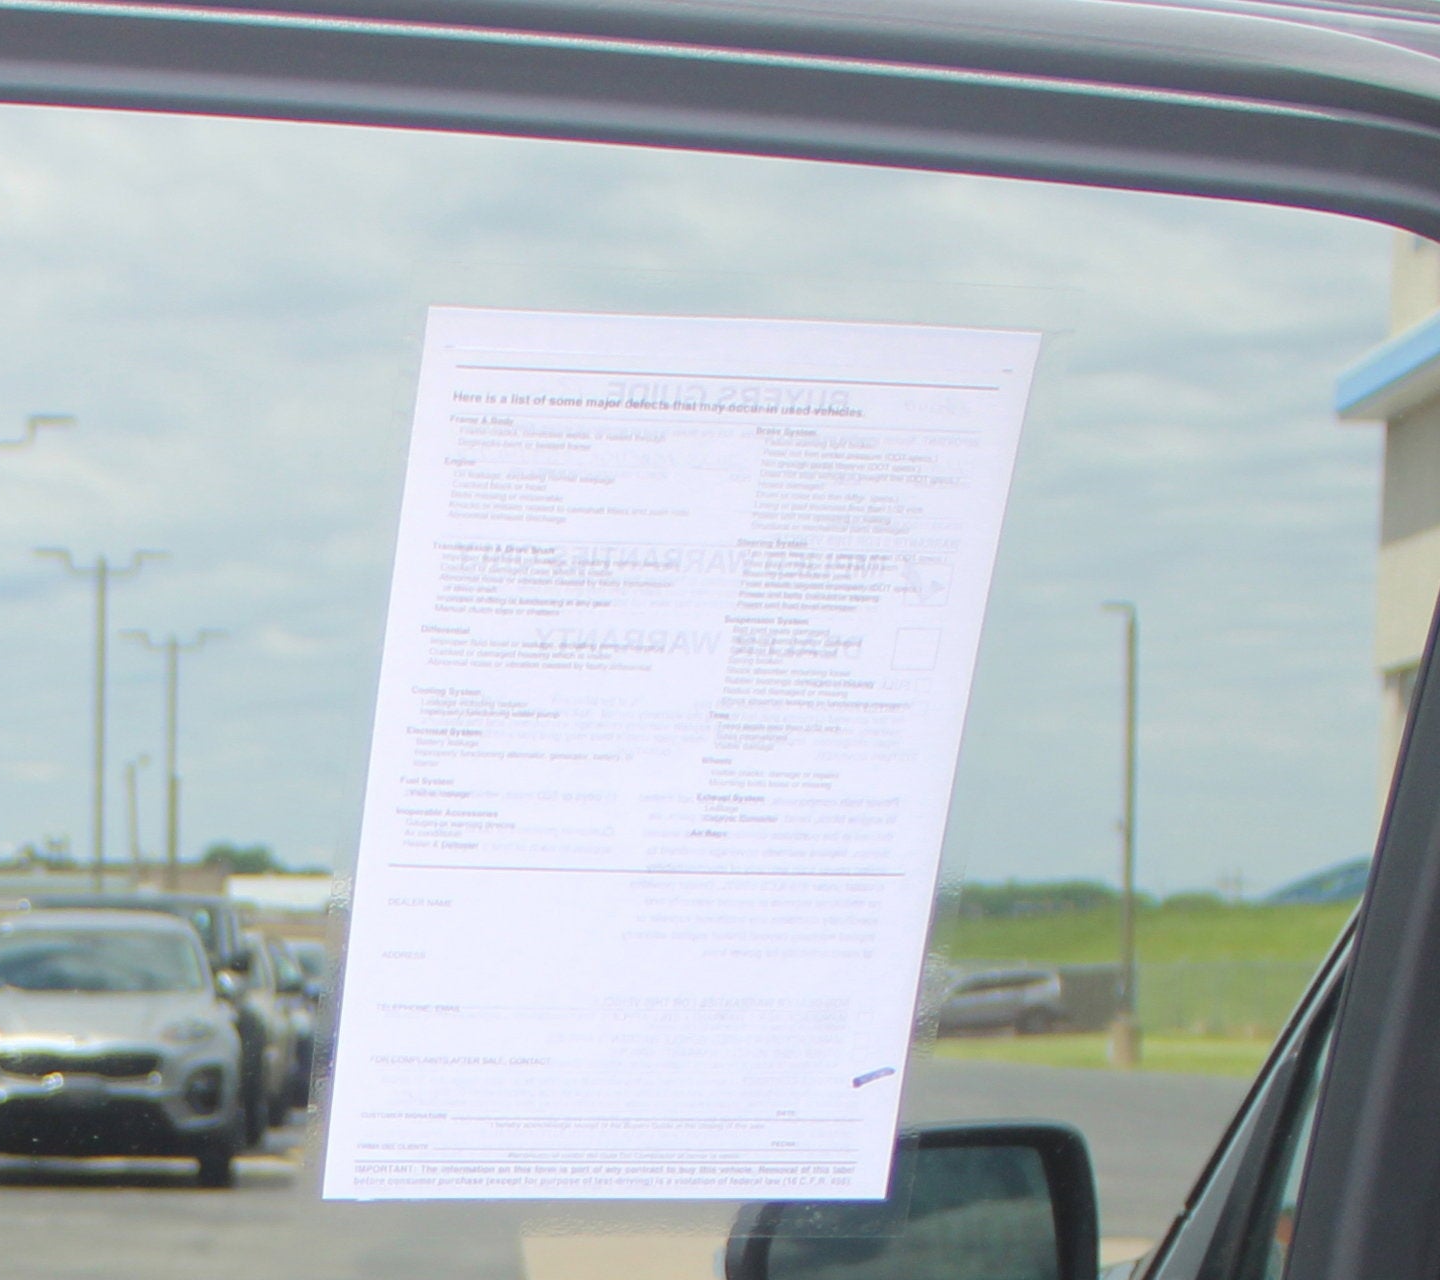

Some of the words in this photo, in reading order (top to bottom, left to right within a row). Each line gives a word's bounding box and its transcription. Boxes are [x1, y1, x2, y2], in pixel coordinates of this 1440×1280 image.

[452, 391, 482, 403] Here
[484, 392, 497, 403] is
[499, 396, 508, 404] a
[510, 393, 531, 405] list
[533, 394, 546, 405] of
[548, 398, 582, 407] some
[585, 397, 620, 411] major
[624, 398, 669, 410] defects
[672, 400, 697, 411] that
[698, 404, 724, 415] may
[728, 405, 763, 414] occur
[765, 403, 778, 414] in
[780, 404, 810, 415] used
[783, 427, 816, 437] System
[443, 456, 476, 467] Engine
[723, 615, 774, 625] Suspension
[776, 616, 808, 626] System
[420, 625, 470, 634] Differential
[410, 686, 446, 696] Cooling
[448, 686, 481, 697] System
[449, 727, 482, 737] System
[399, 776, 419, 785] Fuel
[421, 776, 454, 786] System
[732, 794, 765, 803] System
[387, 898, 424, 907] DEALER
[426, 898, 453, 907] NAME
[381, 950, 426, 959] ADDRESS
[369, 1055, 388, 1063] FOR
[449, 1056, 480, 1064] AFTER
[354, 1165, 416, 1173] IMPORTANT:
[421, 1165, 438, 1173] The
[440, 1165, 495, 1173] information
[569, 1167, 590, 1175] part
[604, 1167, 622, 1175] any
[678, 1166, 697, 1175] buy
[353, 1176, 384, 1184] before
[437, 1176, 484, 1186] purchase
[486, 1176, 521, 1186] (except
[523, 1176, 537, 1184] for
[539, 1178, 579, 1186] purpose
[581, 1176, 592, 1184] of
[654, 1176, 664, 1184] is
[674, 1176, 715, 1184] violation
[717, 1176, 727, 1184] of
[728, 1176, 763, 1184] federal
[764, 1176, 781, 1184] law
